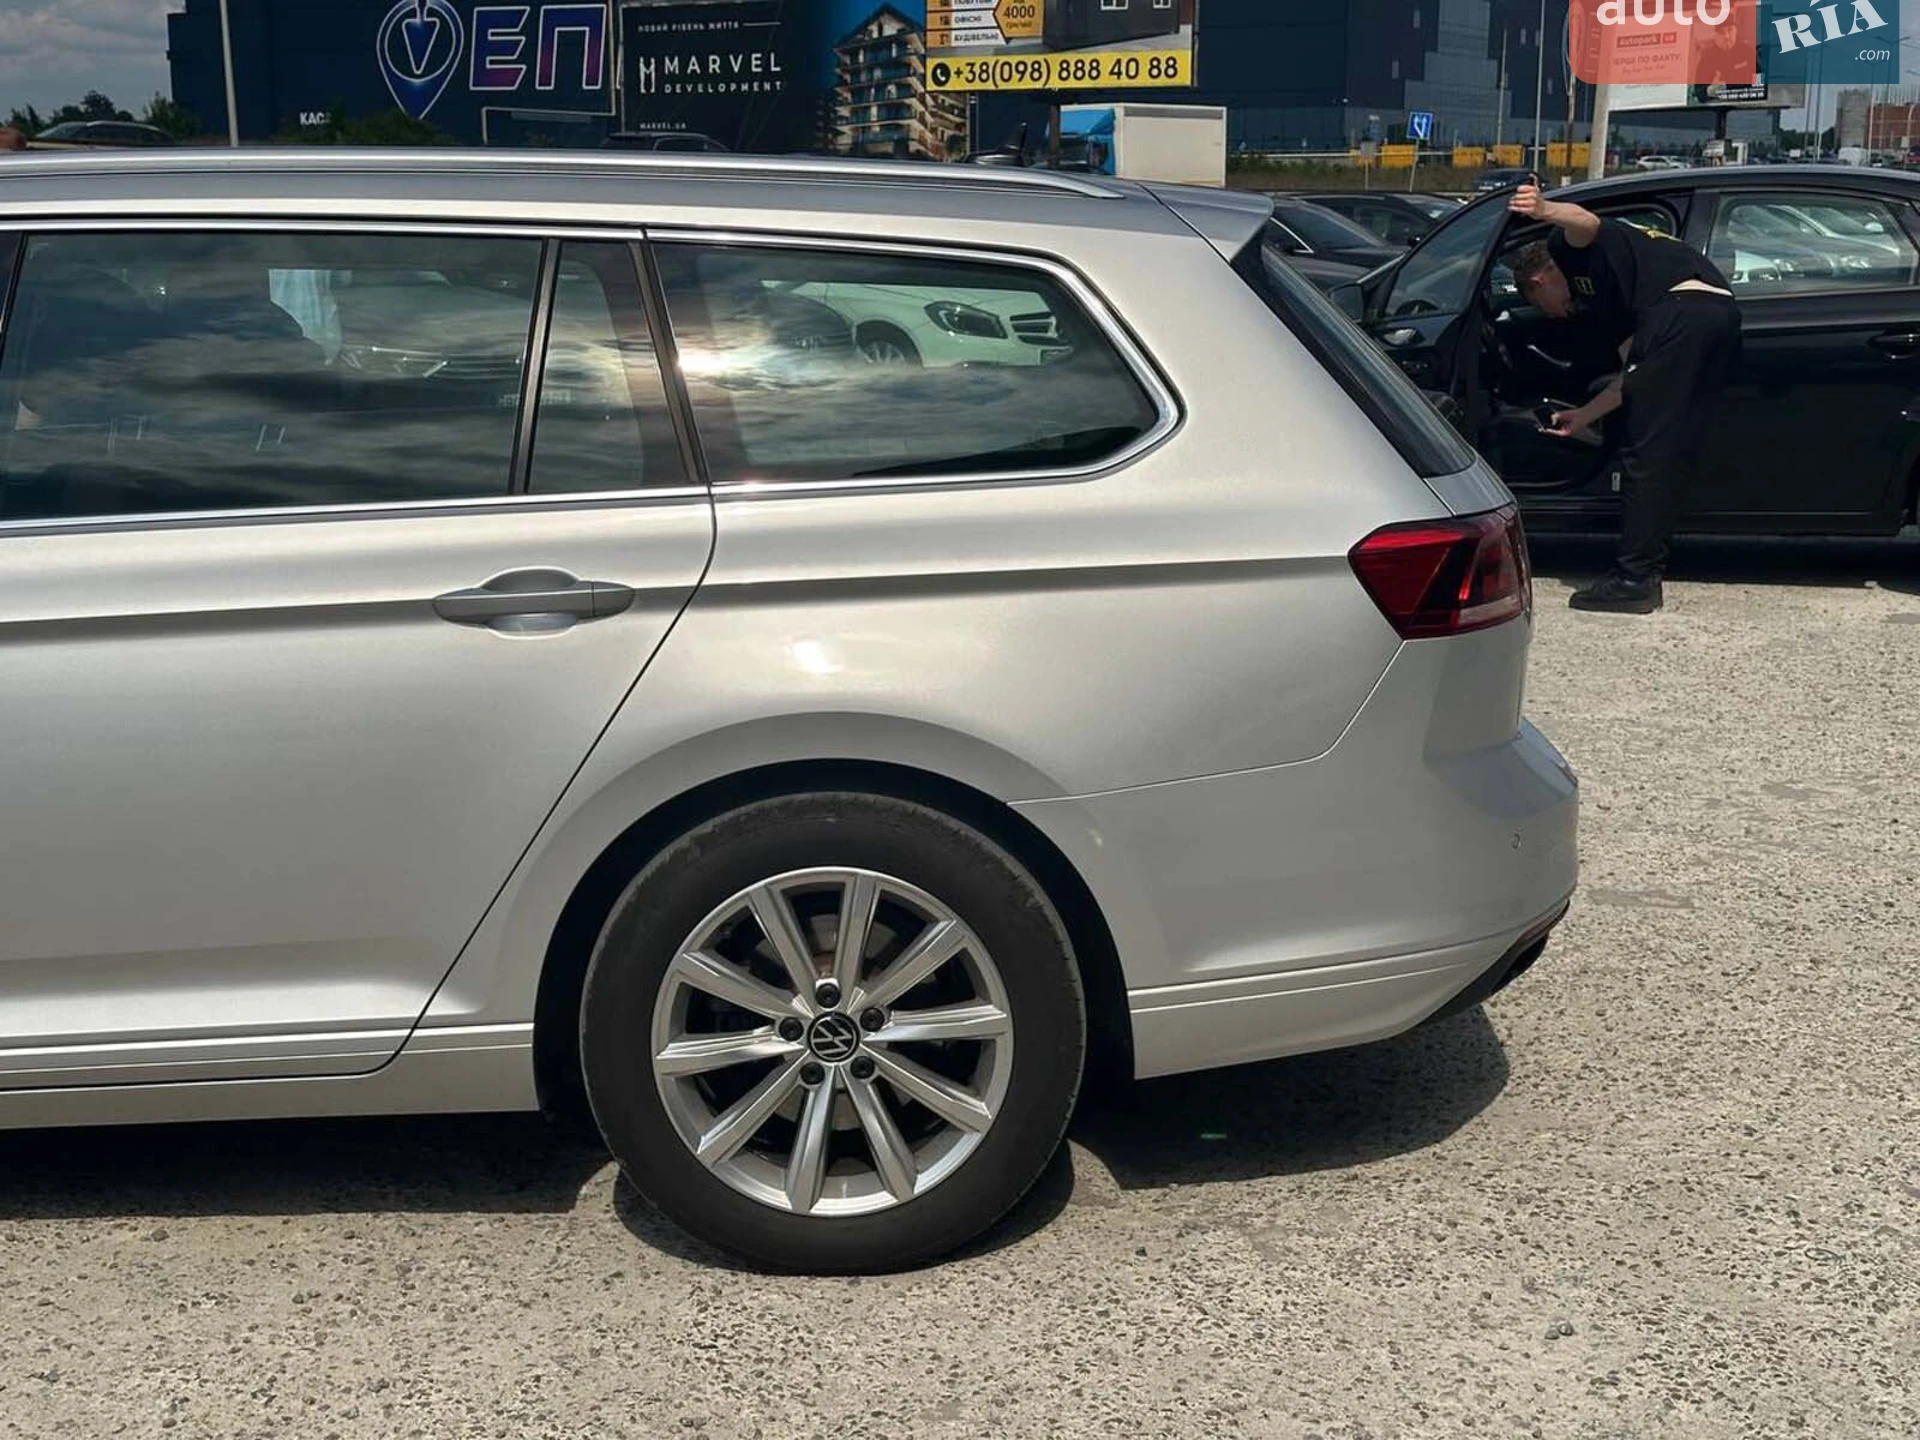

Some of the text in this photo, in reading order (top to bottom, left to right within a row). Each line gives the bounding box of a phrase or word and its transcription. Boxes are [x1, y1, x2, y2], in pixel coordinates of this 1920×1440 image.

[1002, 4, 1035, 19] 4000
[664, 52, 782, 75] MARVEL
[953, 56, 1179, 88] +38(098) 888 40 88
[664, 81, 782, 94] DEVELOPMENT
